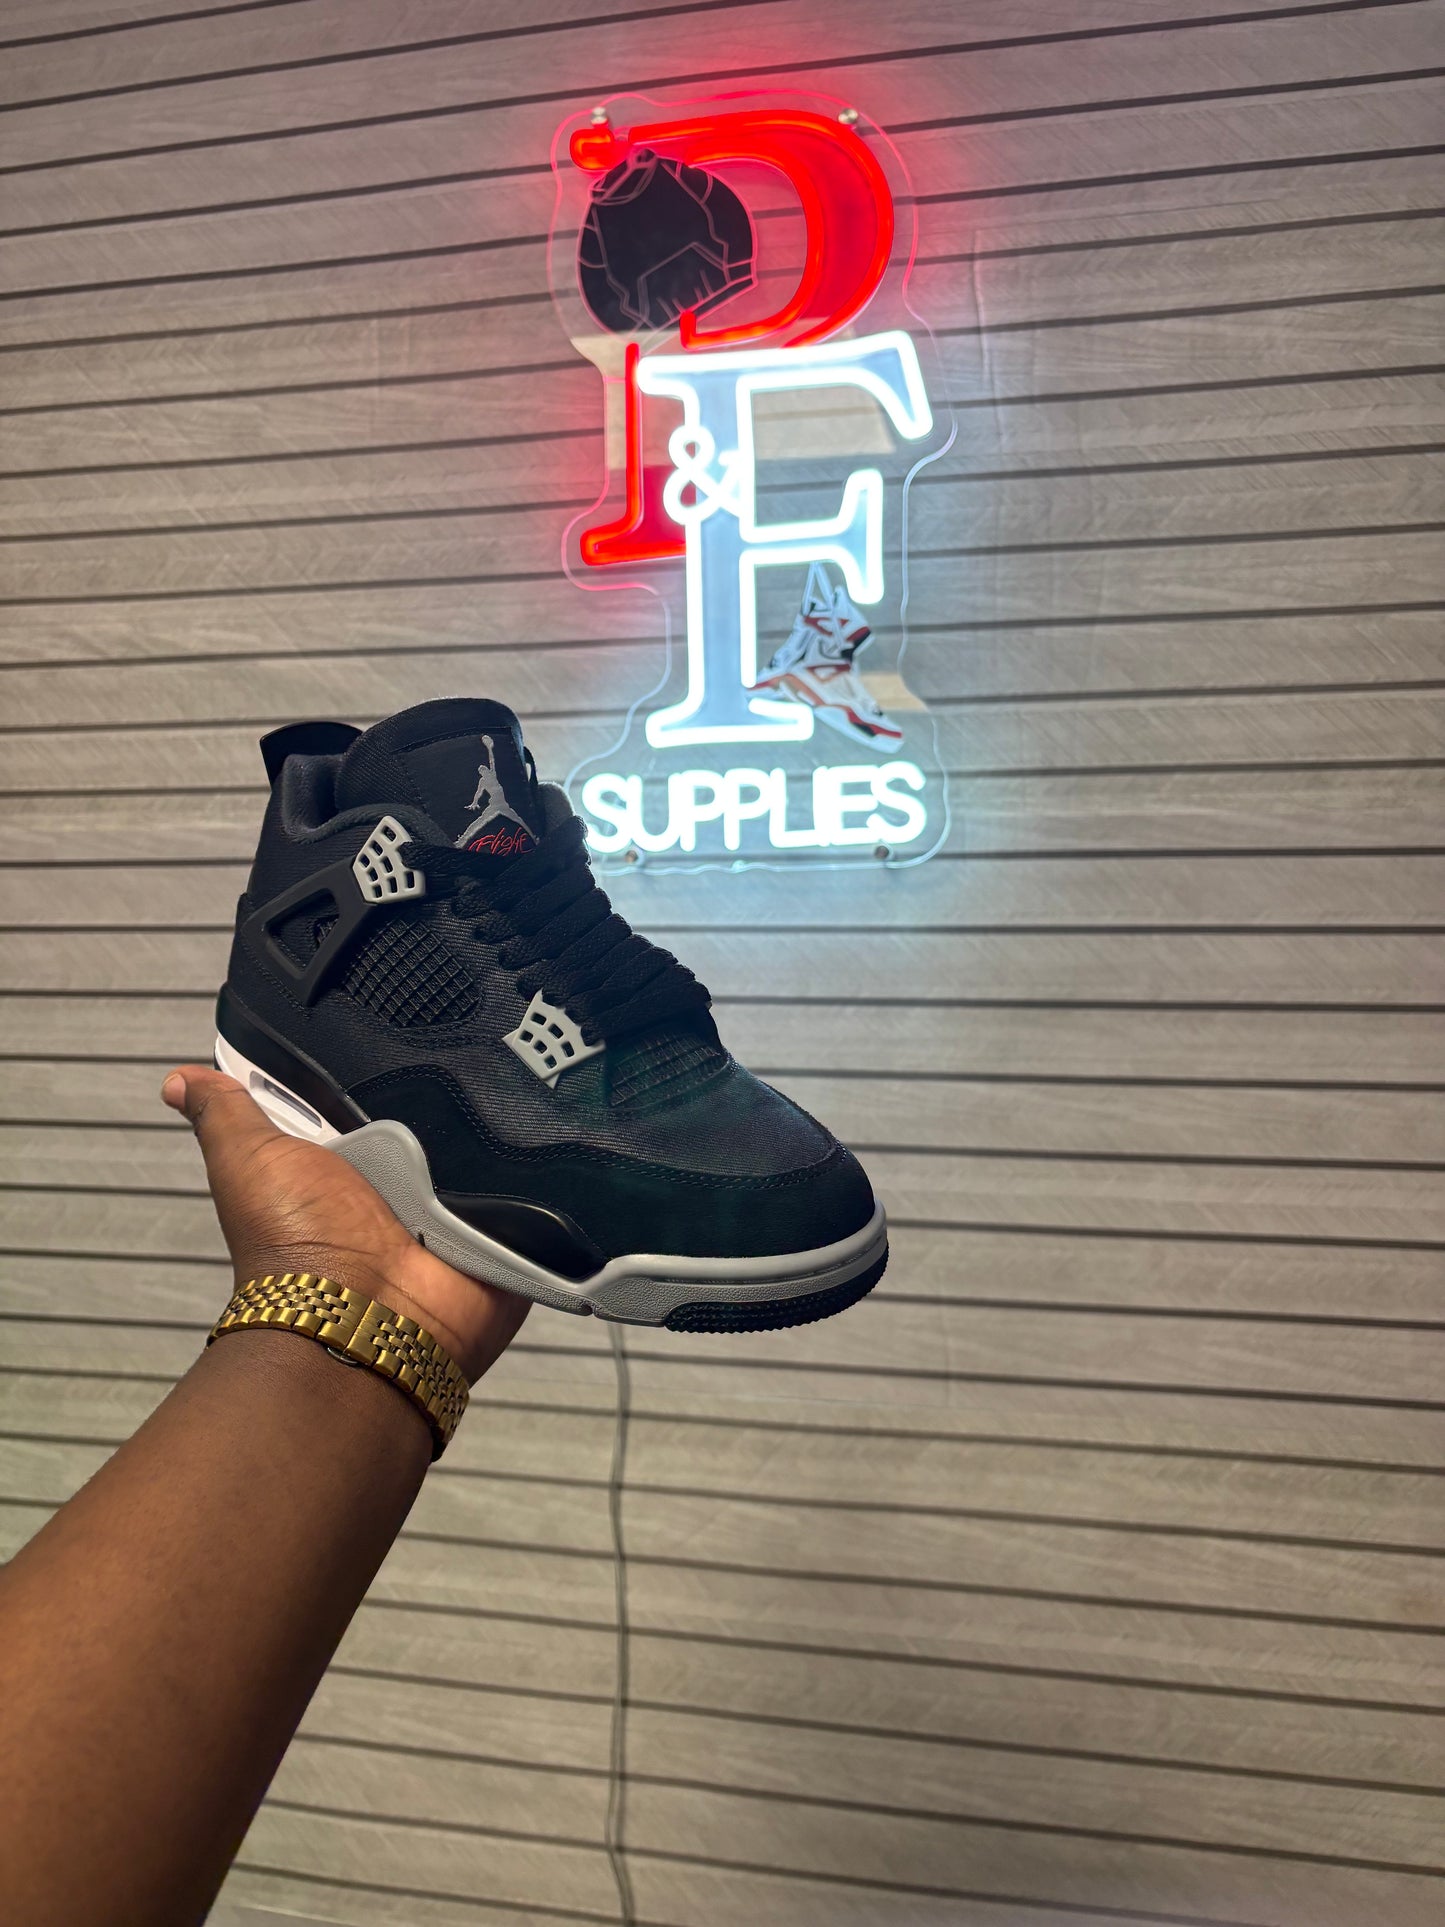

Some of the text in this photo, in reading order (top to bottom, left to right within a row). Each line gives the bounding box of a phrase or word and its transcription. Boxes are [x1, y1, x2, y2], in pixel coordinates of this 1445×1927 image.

[663, 425, 741, 526] &
[635, 329, 934, 749] F
[468, 827, 534, 857] Flight
[581, 760, 928, 854] SUPPLIES
